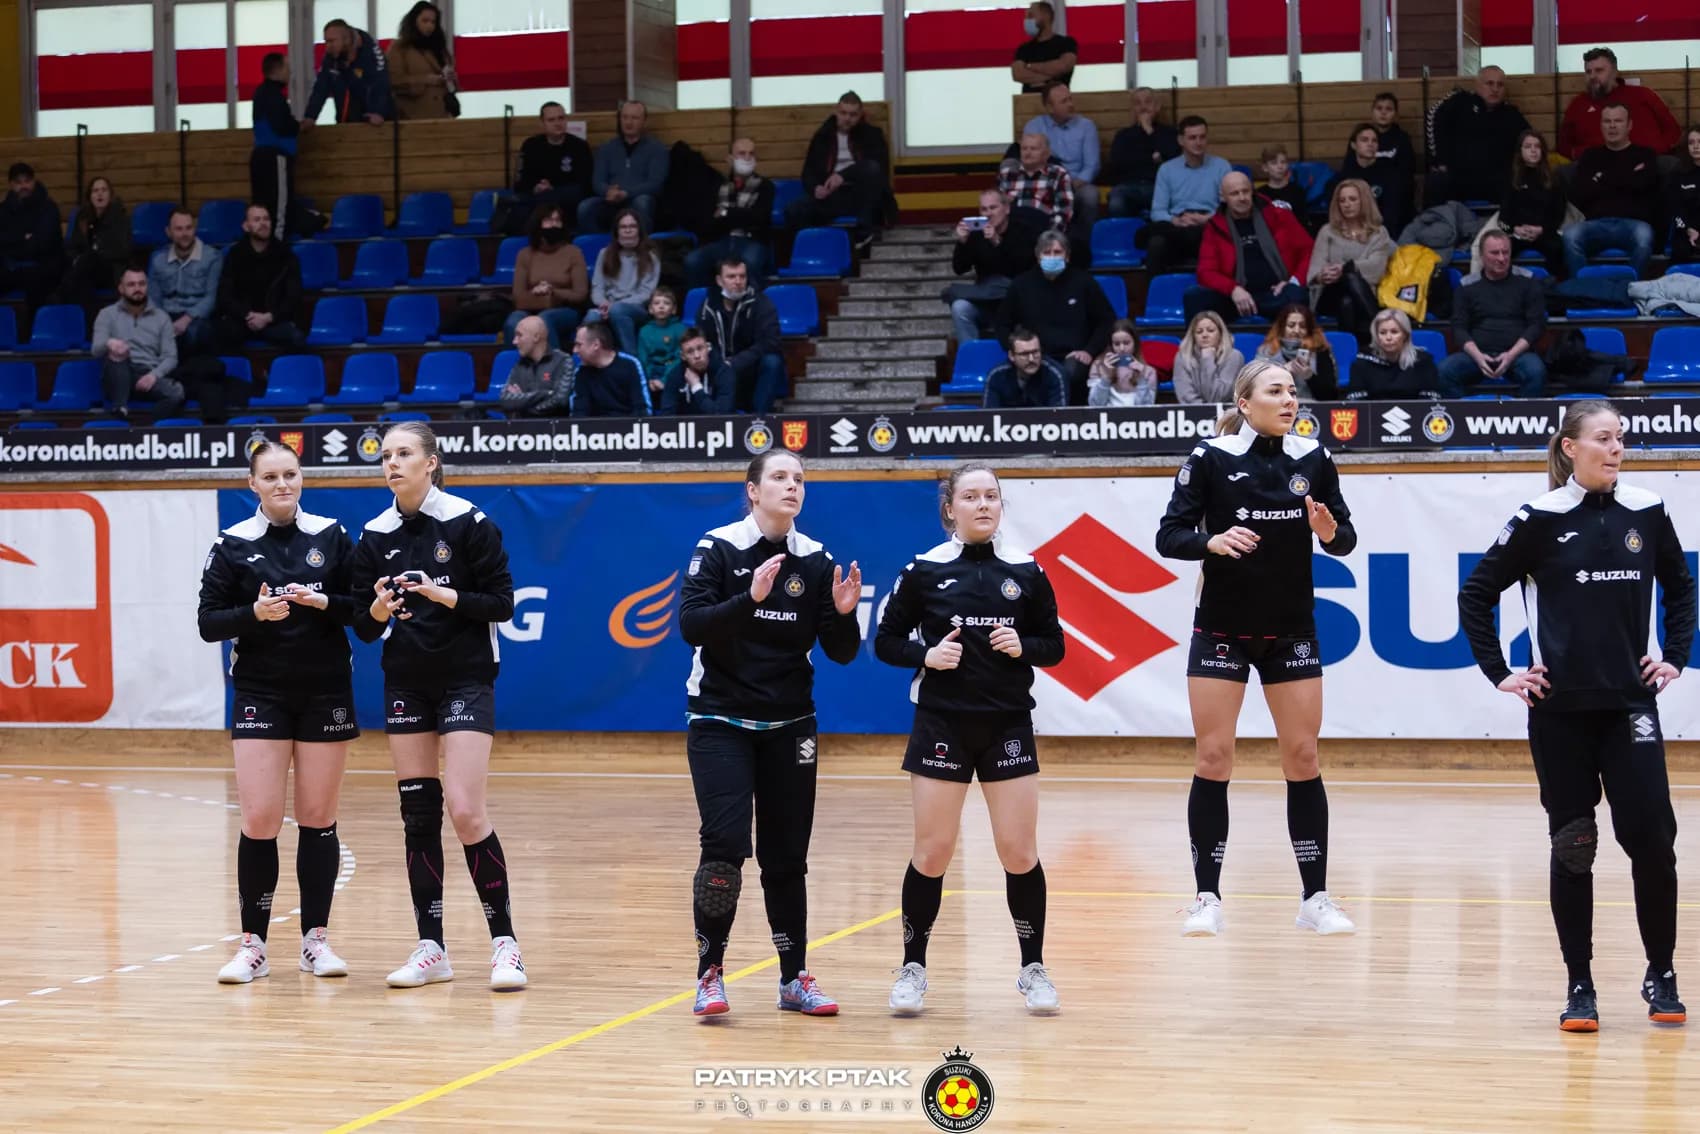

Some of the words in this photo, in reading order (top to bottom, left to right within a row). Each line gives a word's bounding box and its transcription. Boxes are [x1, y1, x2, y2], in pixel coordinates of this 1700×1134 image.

[1251, 508, 1302, 520] SUZUKI
[1591, 570, 1641, 581] SUZUKI
[753, 608, 797, 621] SUZUKI
[965, 616, 1015, 626] SUZUKI
[1286, 657, 1320, 668] PROFIKA
[997, 755, 1032, 768] PROFIKA
